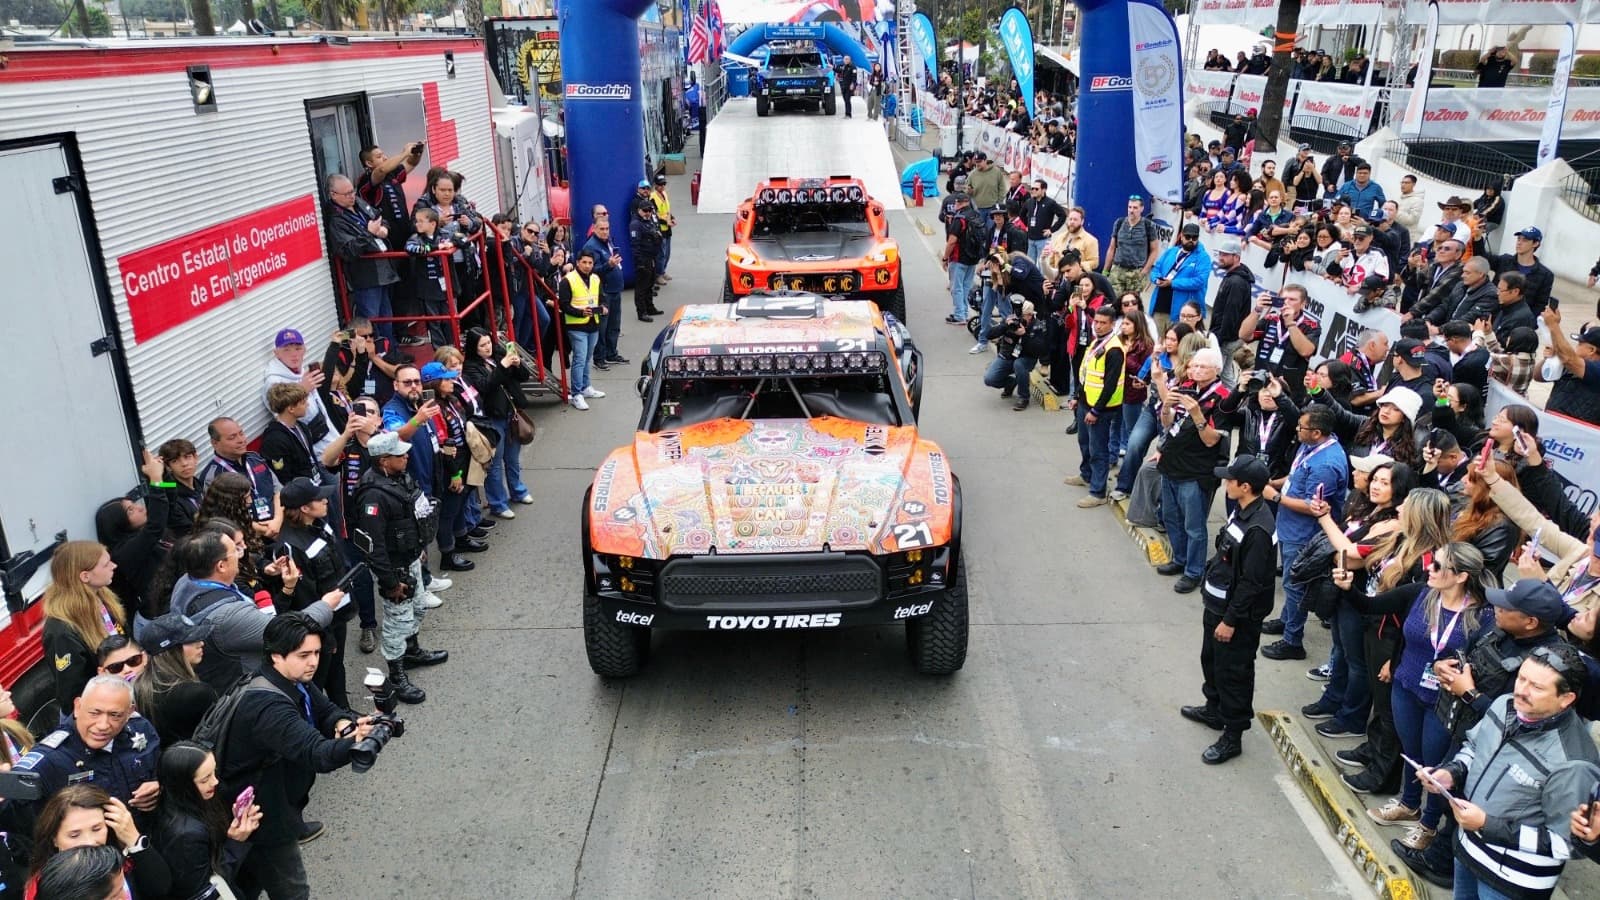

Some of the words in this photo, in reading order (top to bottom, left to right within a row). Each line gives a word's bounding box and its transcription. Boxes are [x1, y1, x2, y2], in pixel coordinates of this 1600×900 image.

[566, 84, 631, 95] BFGoodrich
[1092, 77, 1132, 88] BFGoo
[1337, 104, 1372, 119] AutoZne
[1423, 108, 1469, 121] toZone
[1487, 108, 1546, 121] AutoZon
[1572, 108, 1600, 121] Auto
[125, 261, 180, 297] Centro
[182, 238, 231, 275] Estatal
[233, 234, 248, 252] de
[250, 210, 316, 249] Operaciones
[190, 284, 208, 307] de
[209, 252, 287, 297] Emergencias
[1542, 438, 1585, 461] drich
[744, 485, 801, 496] BECAUSE
[894, 521, 934, 548] 21
[615, 609, 655, 626] telcel
[893, 600, 935, 619] telcel
[706, 615, 771, 629] TOYO
[773, 612, 842, 629] TIRES
